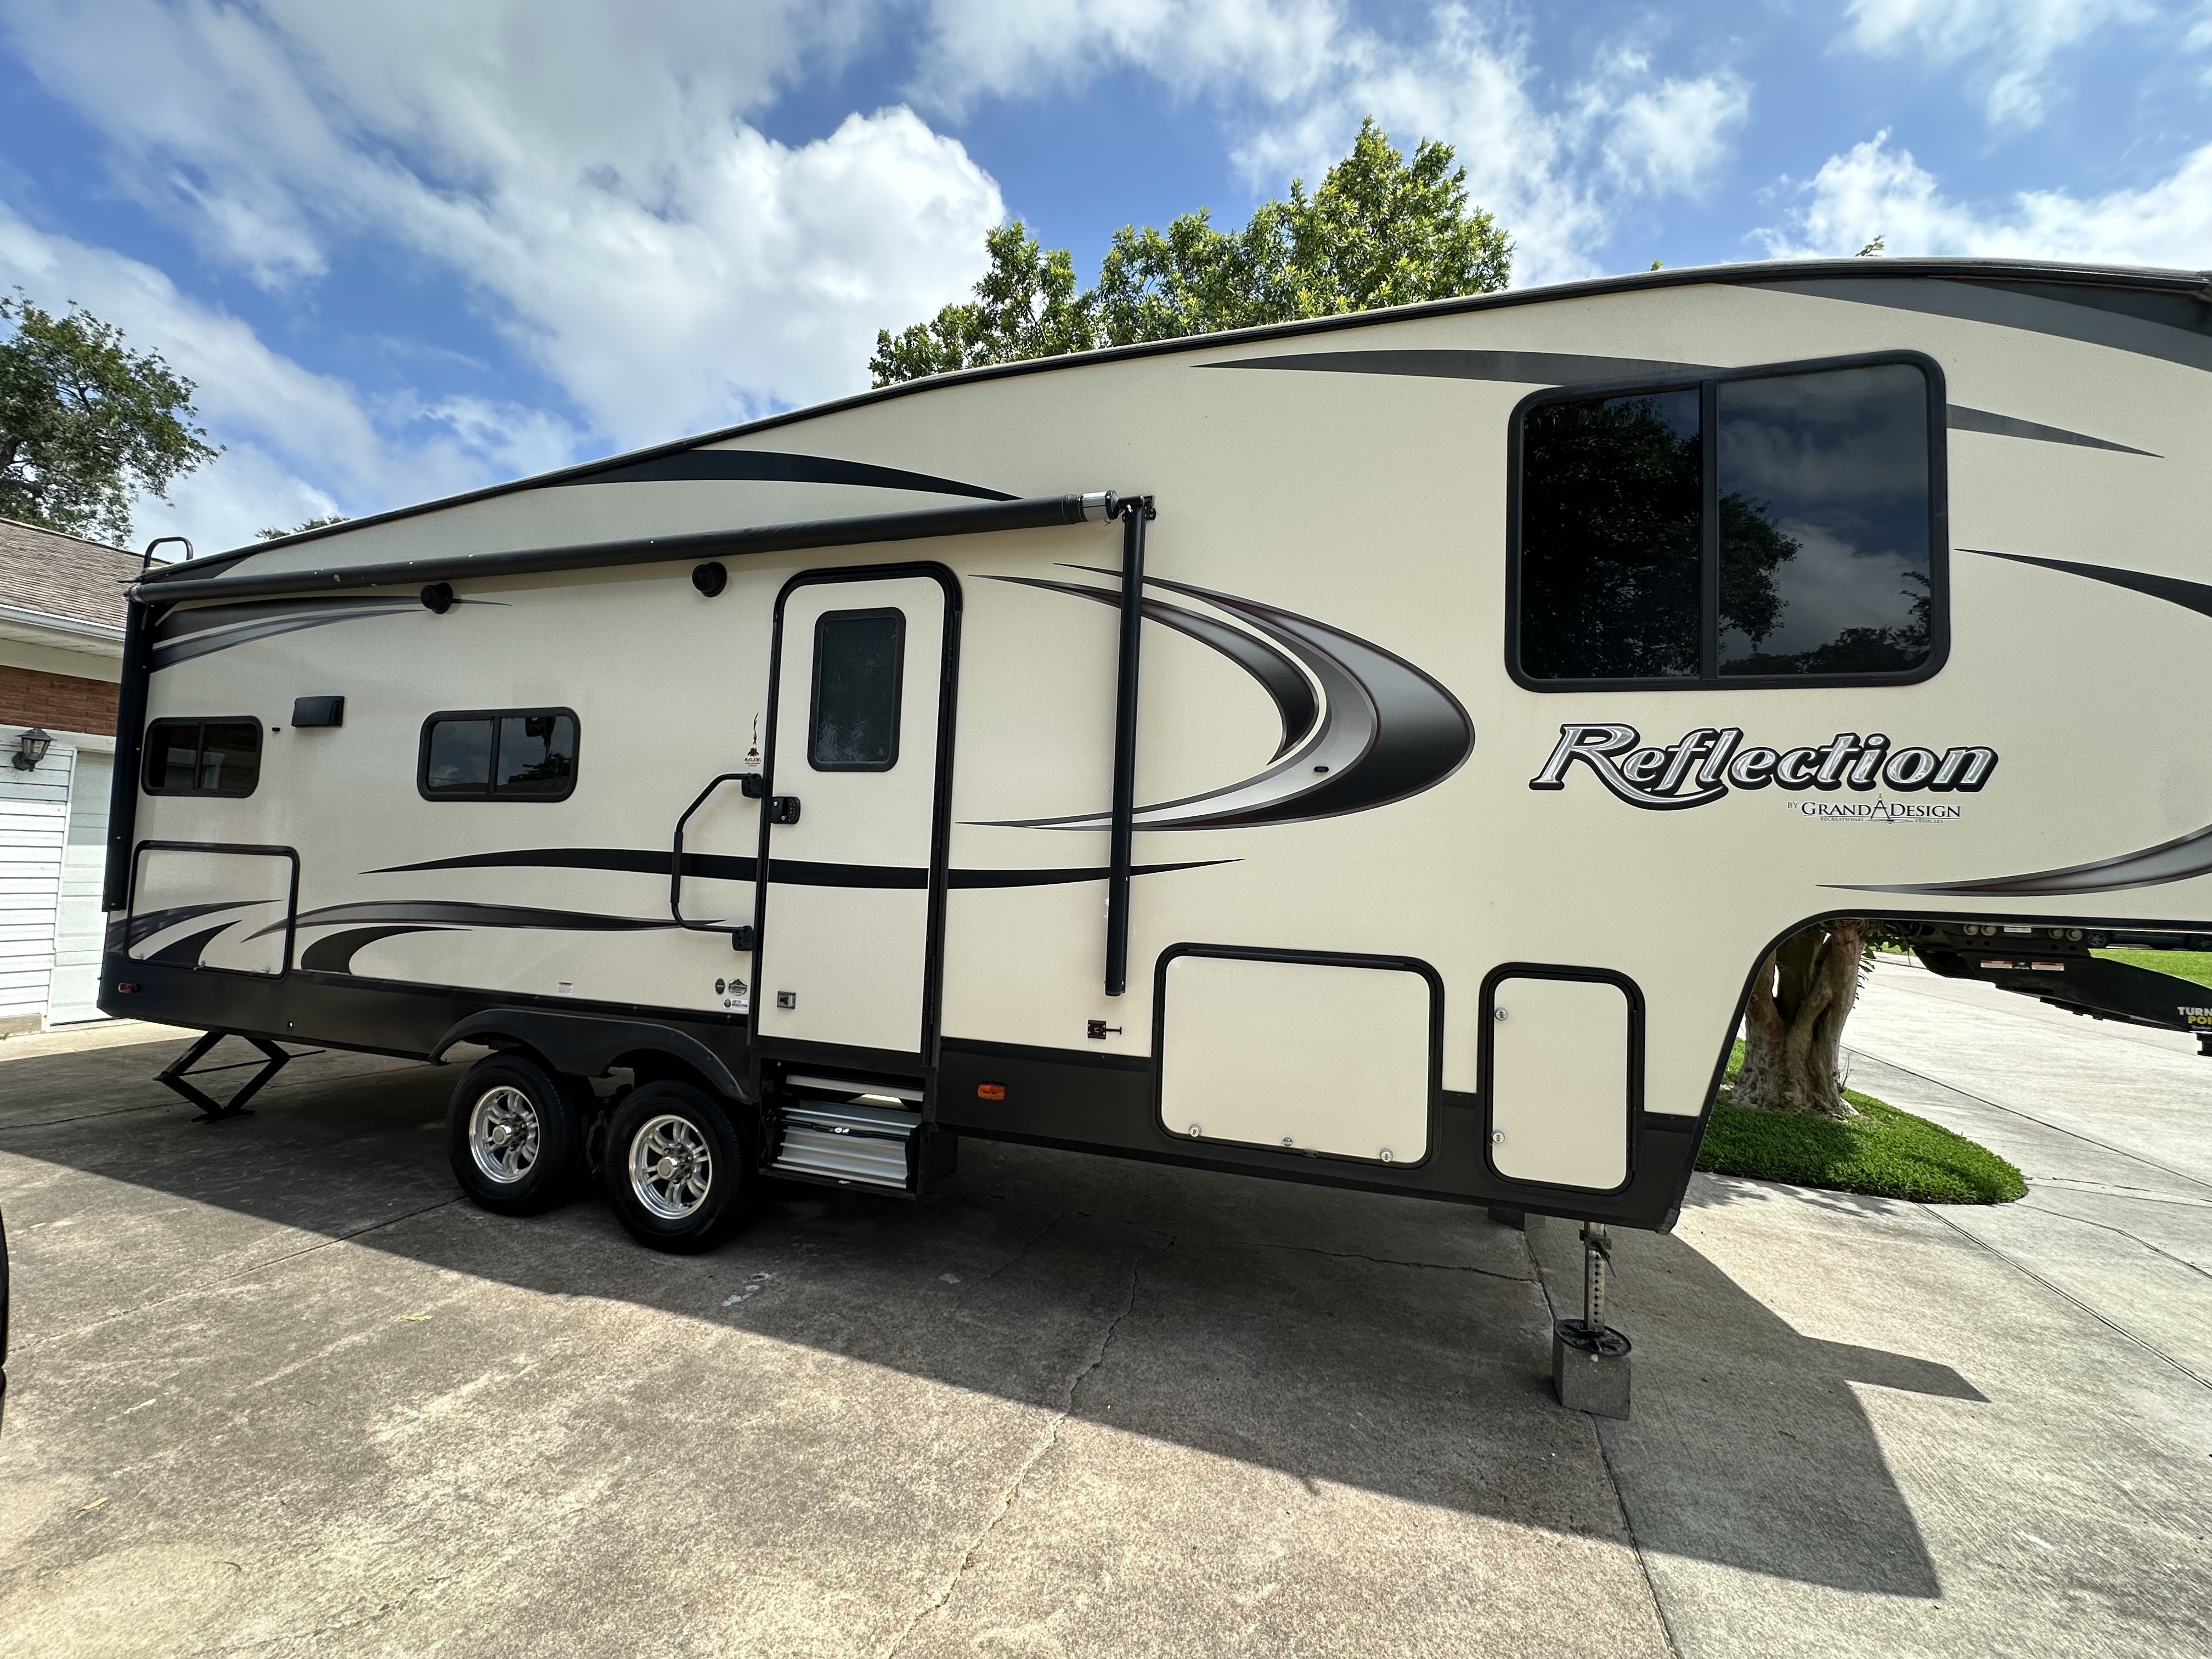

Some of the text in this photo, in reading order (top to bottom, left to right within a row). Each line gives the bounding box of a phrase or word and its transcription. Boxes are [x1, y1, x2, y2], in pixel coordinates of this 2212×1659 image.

[1528, 723, 1999, 810] Reflection
[1801, 802, 1871, 816] GRAND
[1889, 803, 1961, 817] DESIGN
